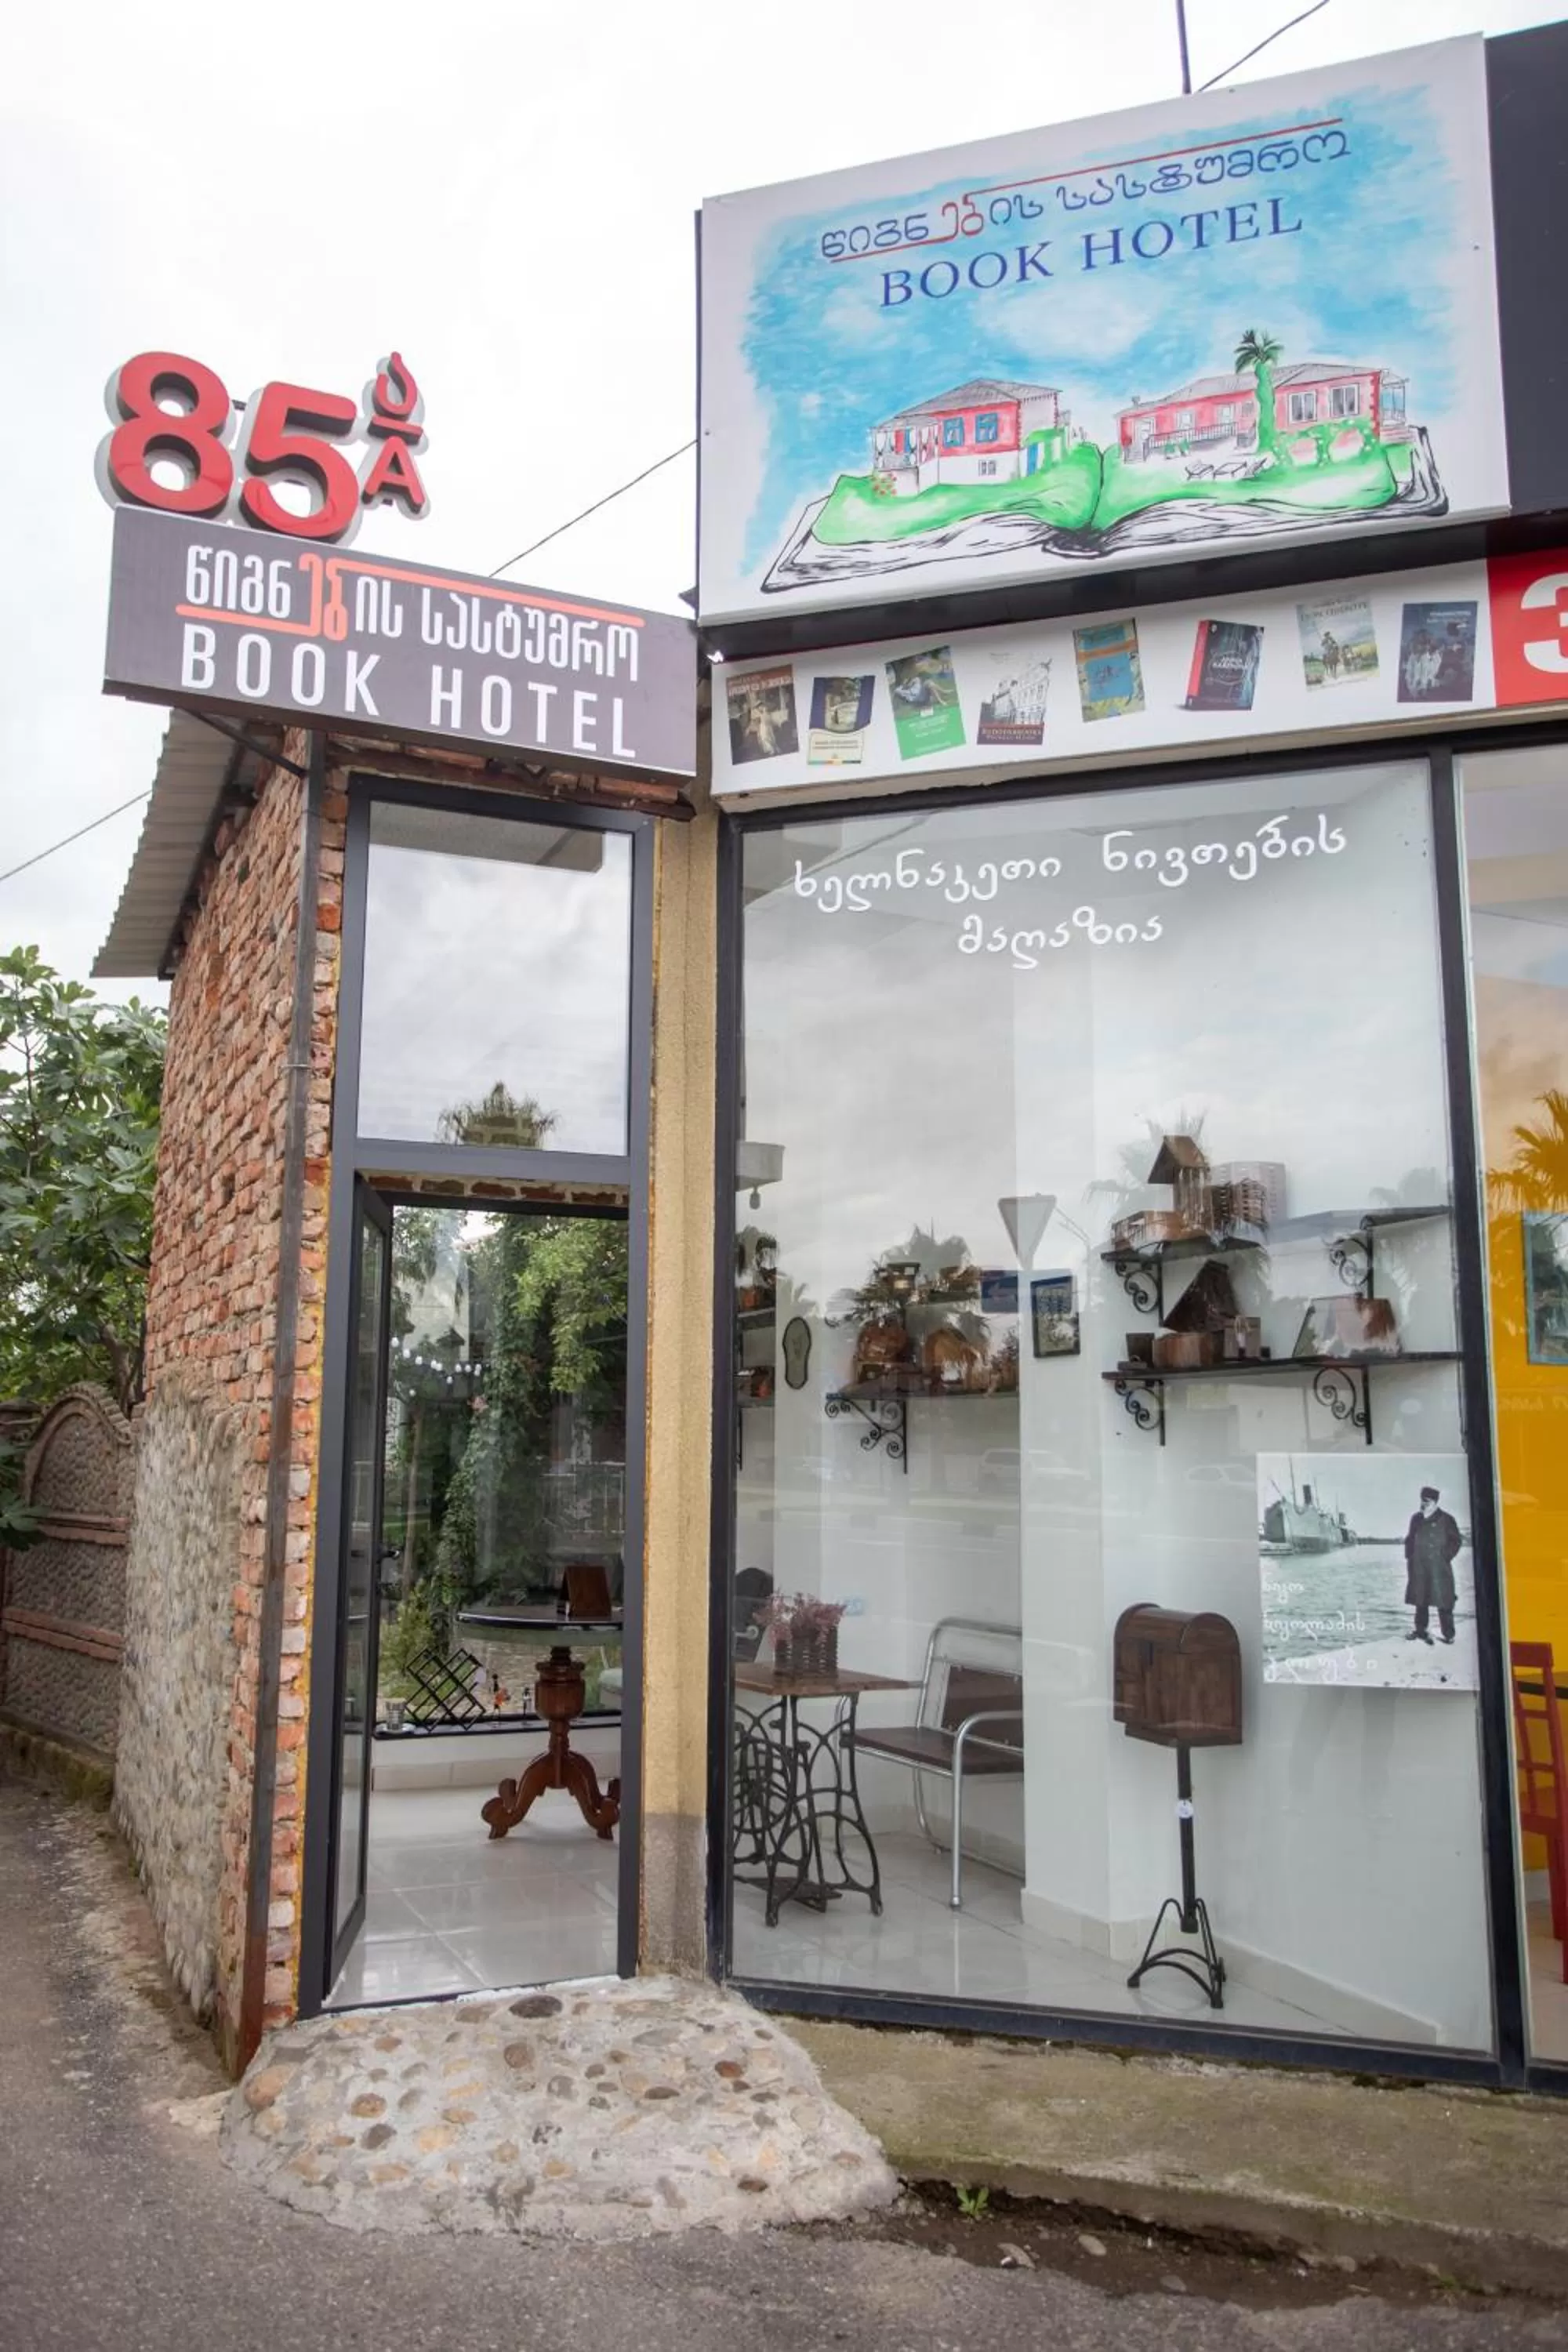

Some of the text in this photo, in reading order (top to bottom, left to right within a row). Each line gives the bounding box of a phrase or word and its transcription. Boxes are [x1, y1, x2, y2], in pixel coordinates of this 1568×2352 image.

[822, 131, 1351, 262] წიგნების სასტუმრო
[879, 197, 1303, 307] BOOK HOTEL
[108, 350, 359, 541] 85
[365, 435, 426, 510] A
[182, 545, 639, 682] წიგნების სასტუმრო
[181, 622, 637, 758] BOOK HOTEL
[793, 813, 1348, 913] ხელნაკეთი ნივთების
[957, 906, 1163, 970] მაღაზია
